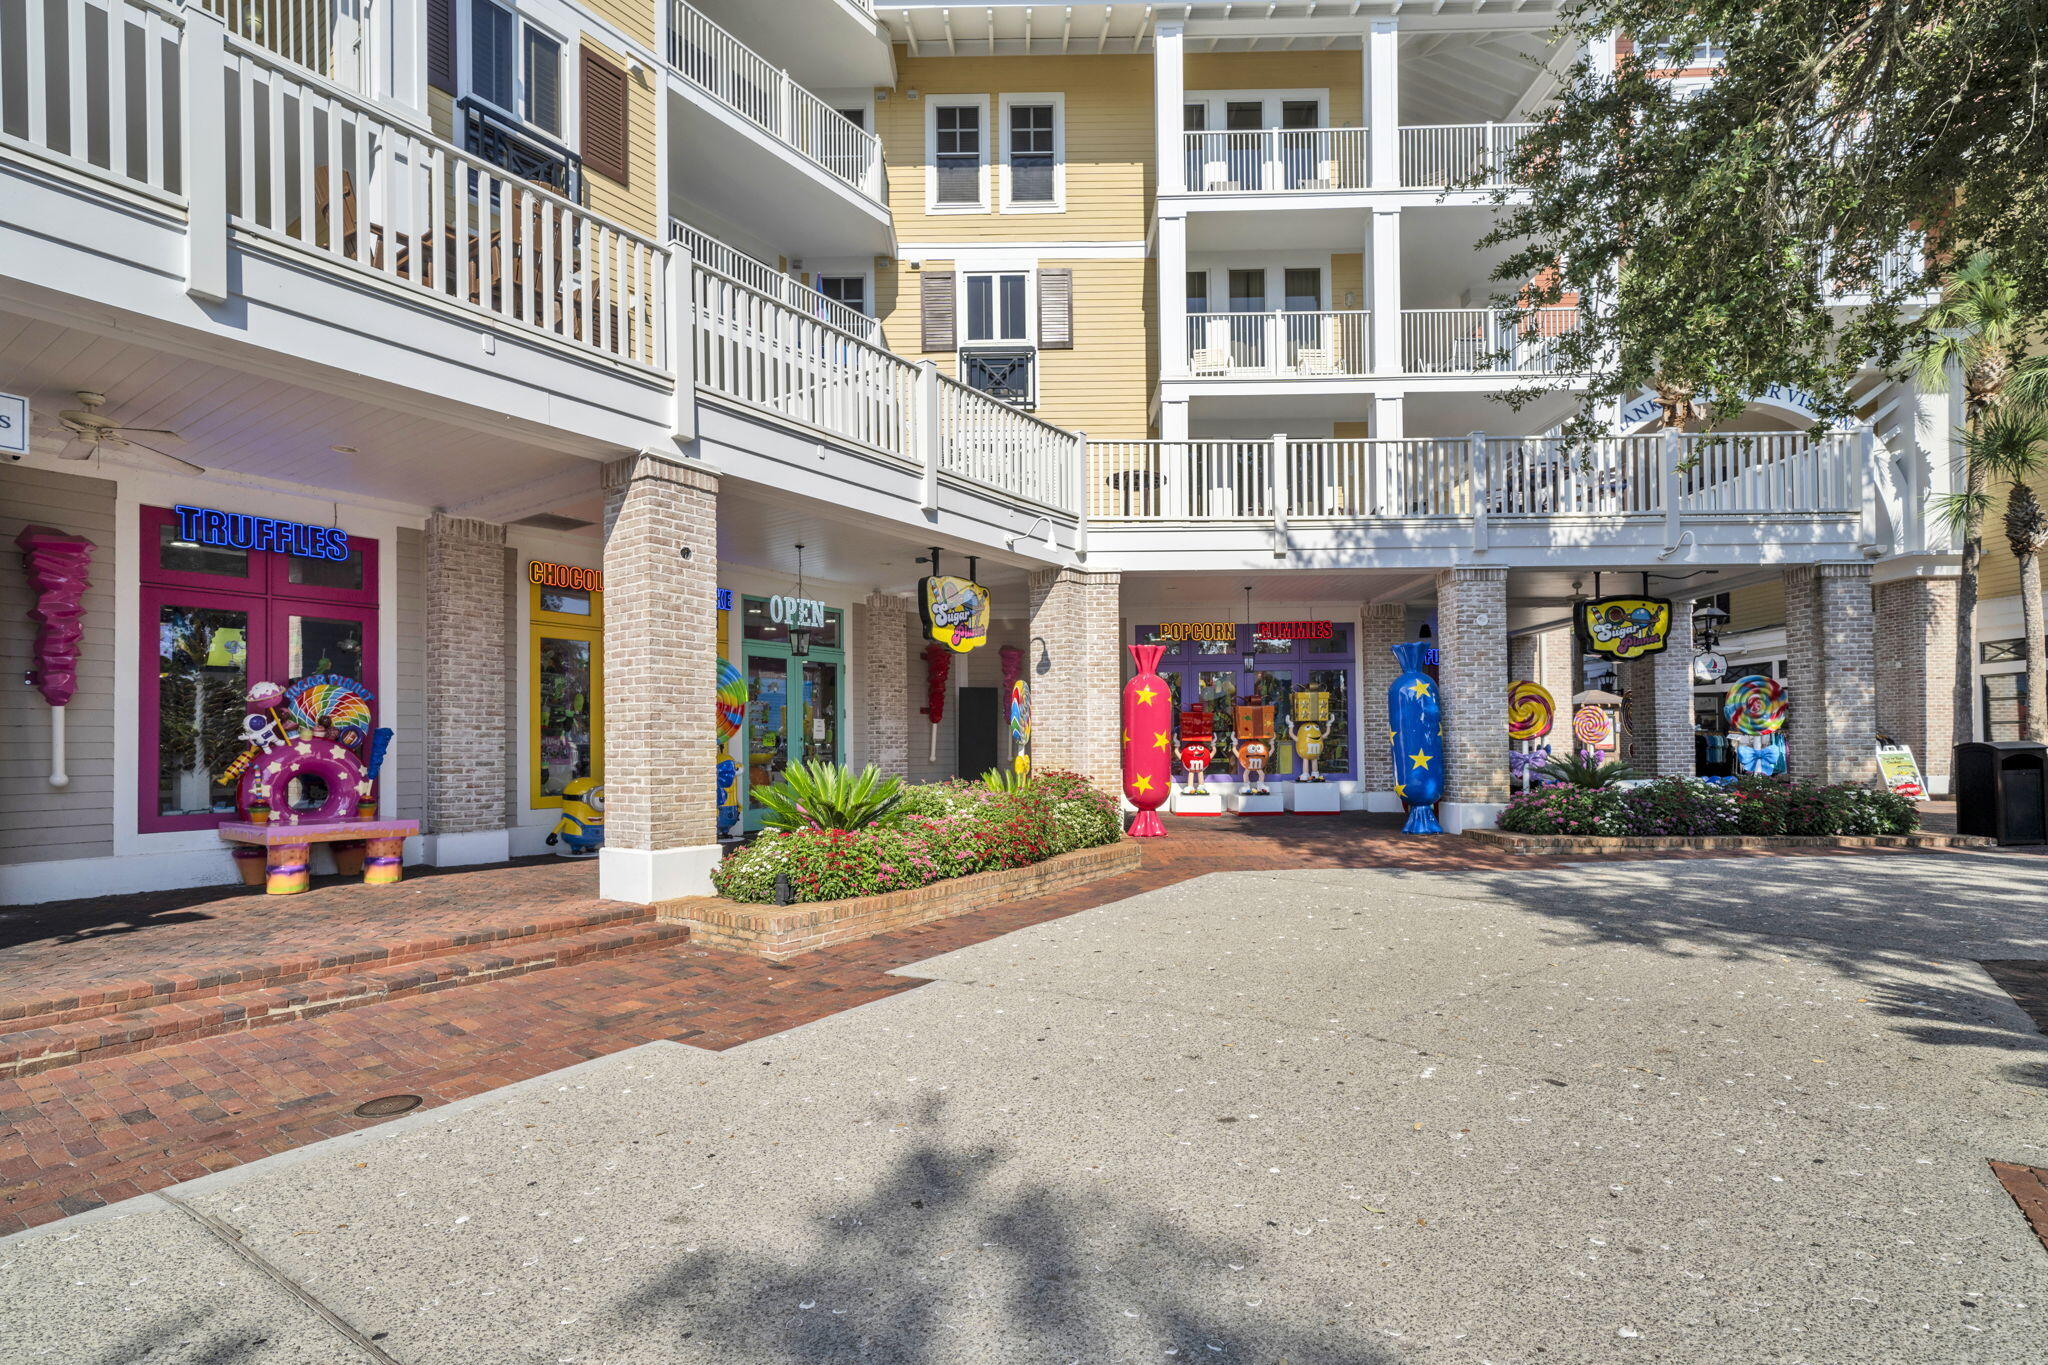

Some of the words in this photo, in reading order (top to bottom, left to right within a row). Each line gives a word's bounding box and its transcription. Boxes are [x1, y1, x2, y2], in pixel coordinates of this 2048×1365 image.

[175, 504, 349, 561] TRUFFLES
[529, 560, 604, 592] CHOCOL
[770, 594, 825, 628] OPEN
[931, 603, 970, 627] Sugar
[1159, 622, 1236, 641] POPCORN
[1257, 621, 1333, 640] GUMMIES
[1593, 623, 1640, 641] Sugar
[1617, 634, 1661, 654] Planet
[284, 674, 327, 700] SUGAR
